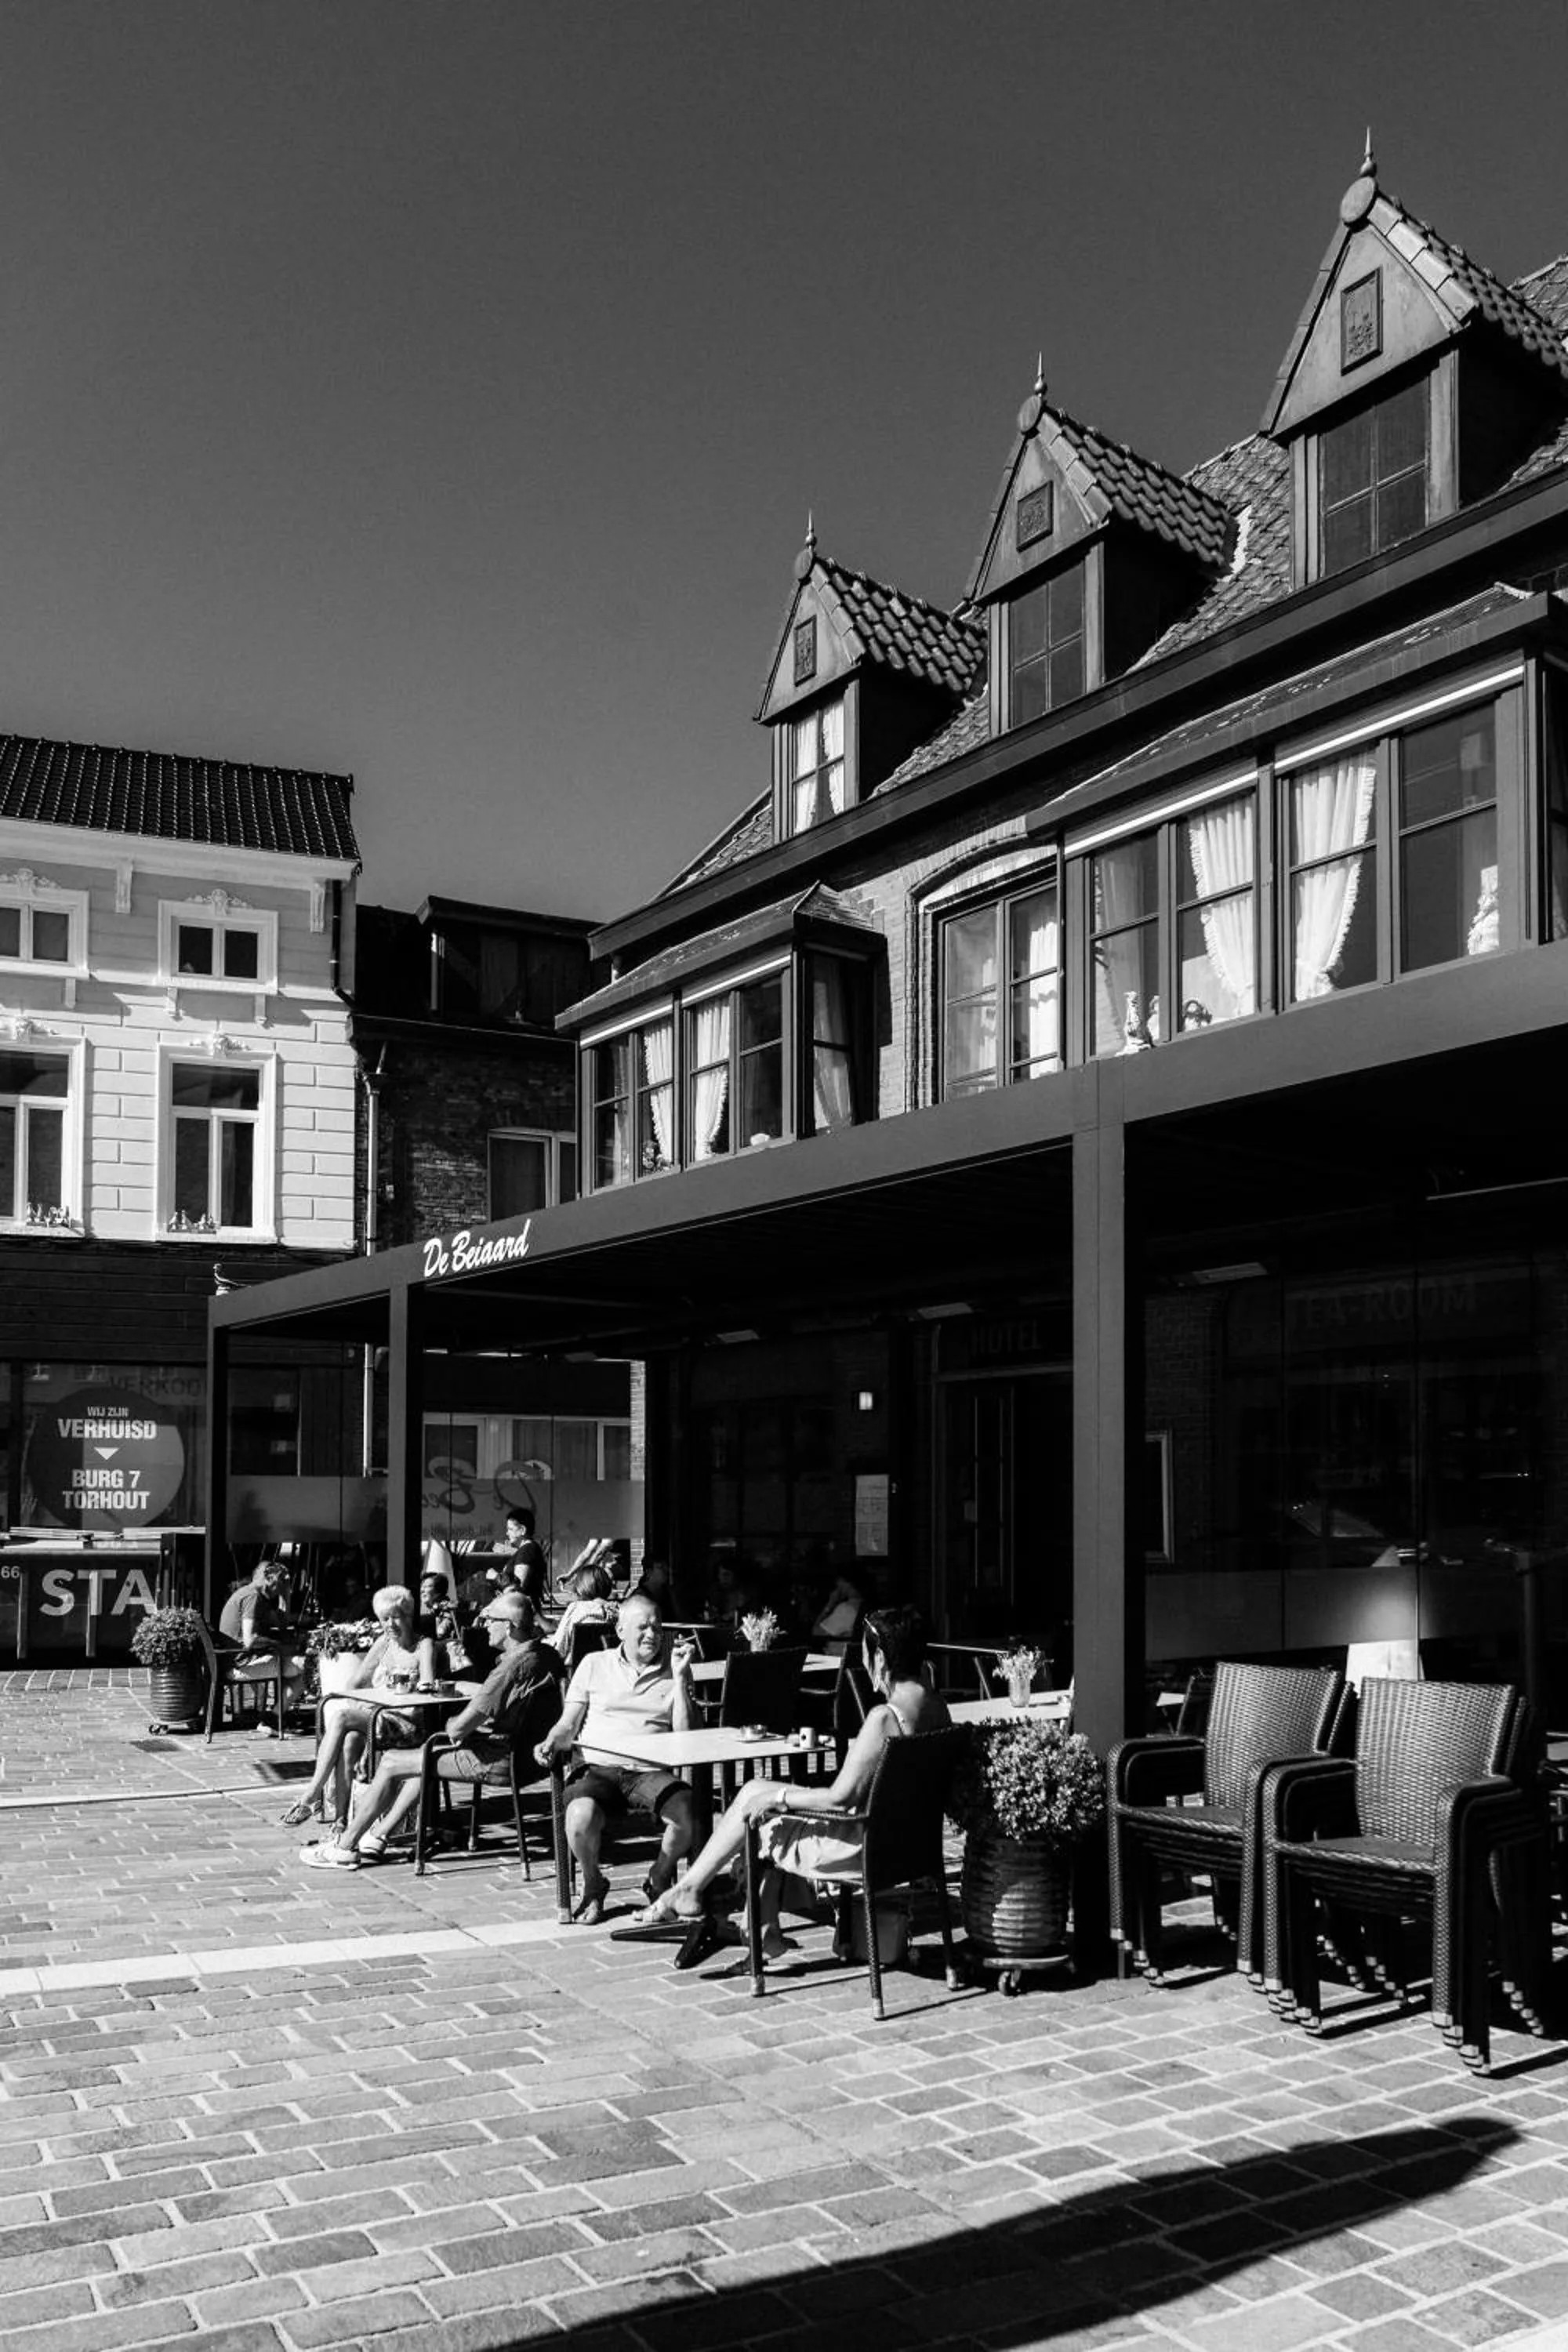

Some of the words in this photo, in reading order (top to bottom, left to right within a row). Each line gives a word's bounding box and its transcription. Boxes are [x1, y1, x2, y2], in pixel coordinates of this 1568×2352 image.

[423, 1237, 449, 1278] De
[451, 1218, 532, 1272] Beiaard
[971, 1319, 1044, 1357] HOTEL
[87, 1406, 105, 1417] WIJ
[107, 1406, 129, 1417] ZIJN
[57, 1418, 157, 1439] VERHUISD
[71, 1469, 124, 1488] BURG
[129, 1470, 140, 1489] 7
[62, 1490, 151, 1509] TORHOUT
[1, 1566, 20, 1580] 66
[40, 1569, 158, 1616] STA
